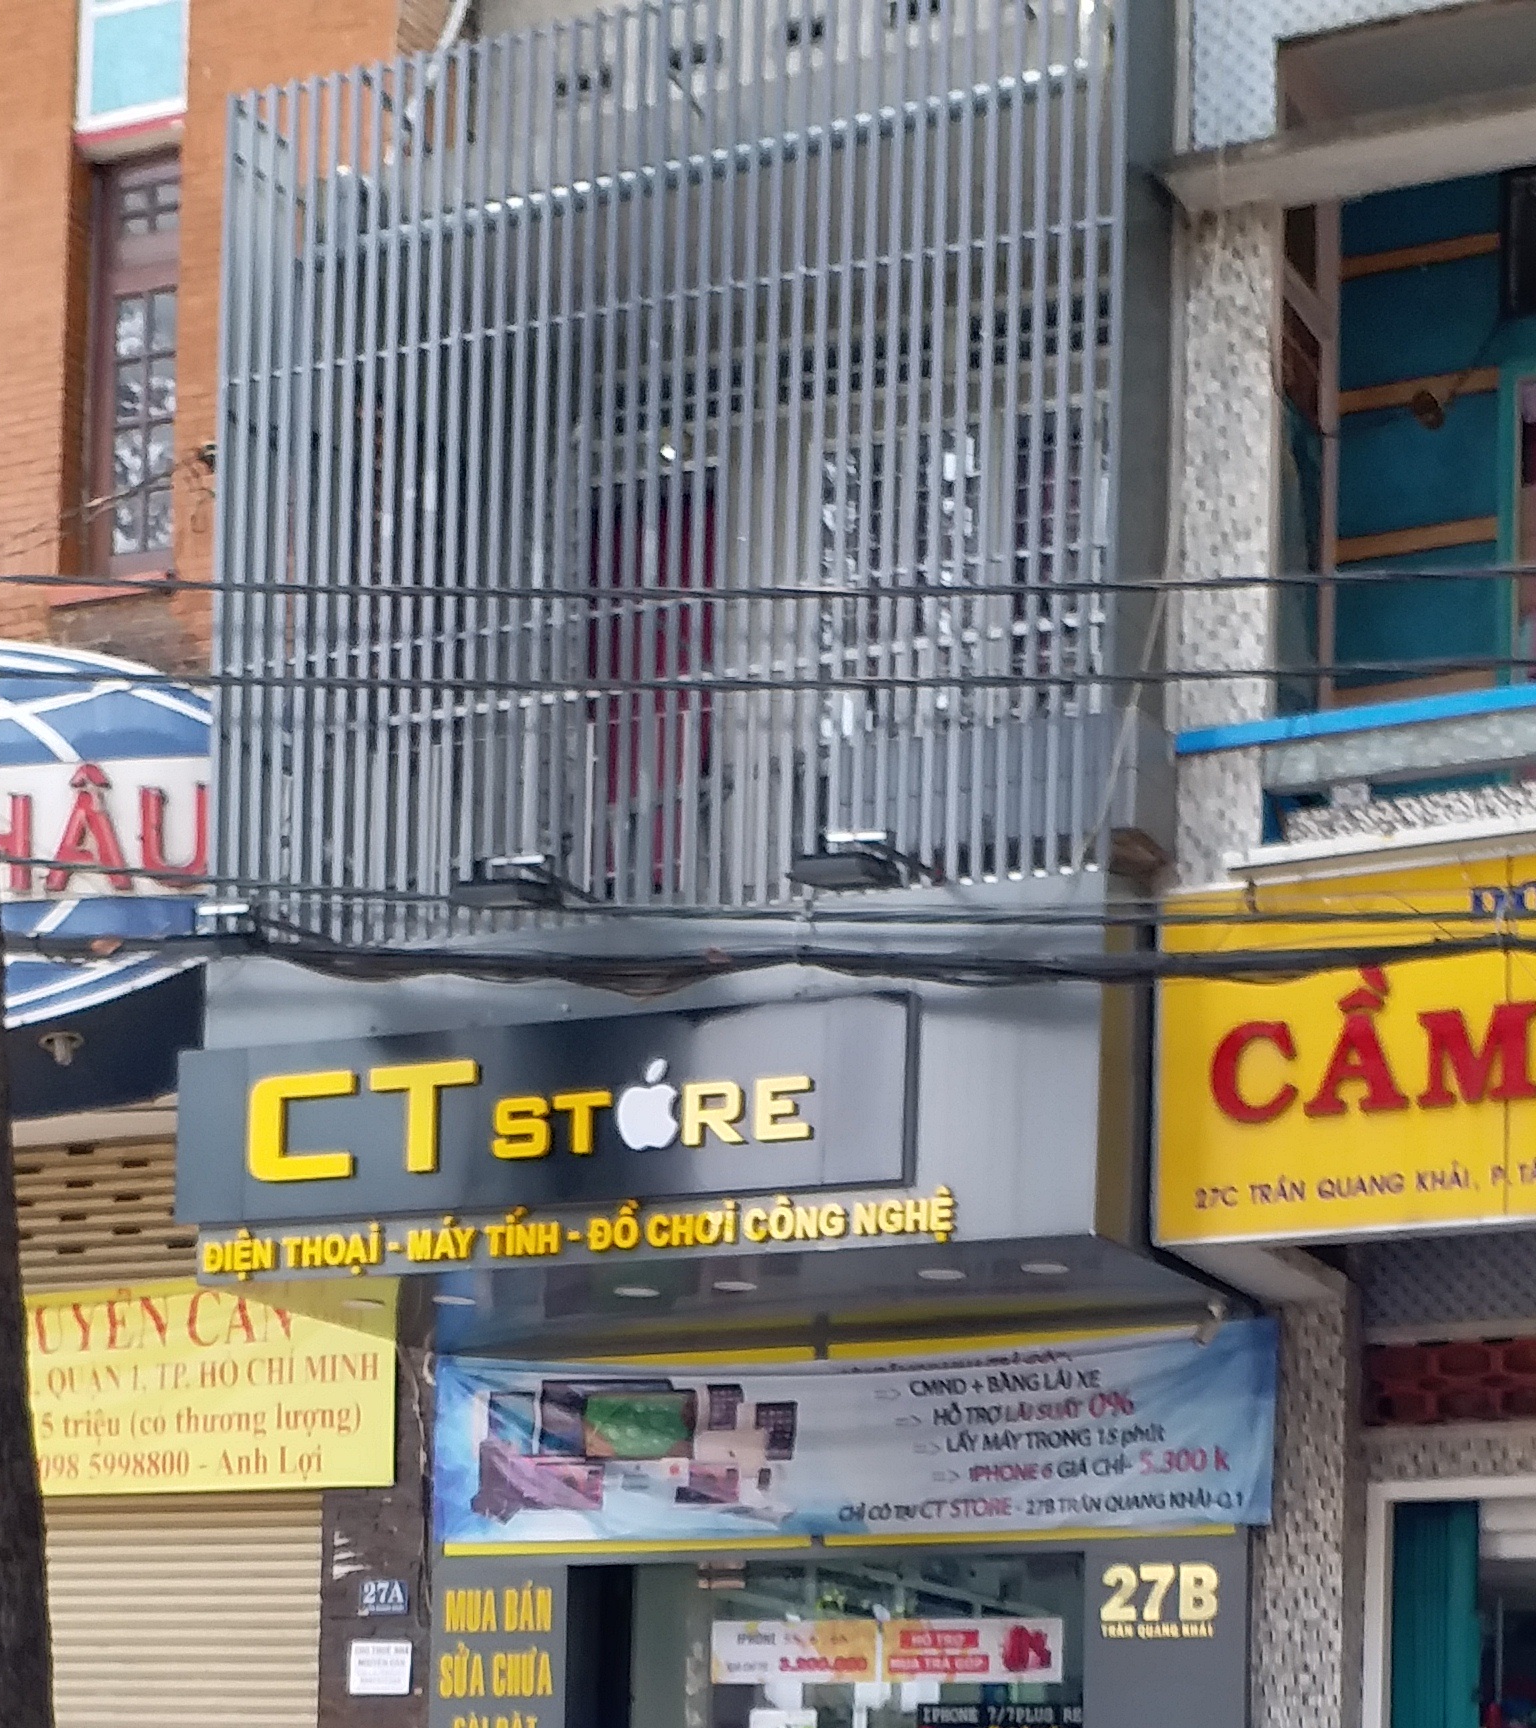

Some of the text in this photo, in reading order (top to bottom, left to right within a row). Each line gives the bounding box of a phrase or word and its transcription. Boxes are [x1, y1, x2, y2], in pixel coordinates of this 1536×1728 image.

[246, 1059, 479, 1182] CT
[1317, 1171, 1405, 1200] QUANG
[202, 1228, 276, 1282] ĐIỆN
[407, 1214, 477, 1263] MÁY
[484, 1204, 562, 1258] TÍNH
[588, 1198, 642, 1253] ĐỒ
[646, 1198, 738, 1249] CHƠI
[744, 1194, 848, 1243] CÔNG
[853, 1186, 957, 1244] NGHỆ
[304, 1351, 381, 1384] MINH
[1077, 1369, 1102, 1389] XE
[64, 1410, 121, 1444] triệu
[175, 1406, 267, 1437] thương
[1025, 1428, 1092, 1450] TRONG
[89, 1450, 191, 1479] 5998800
[219, 1449, 269, 1477] Anh
[279, 1445, 324, 1480] Lợi
[919, 1499, 948, 1519] CT
[363, 1579, 406, 1604] 27A
[444, 1579, 553, 1633] MUA BÁN
[1100, 1561, 1220, 1622] 27B
[1137, 1621, 1180, 1640] QUANG
